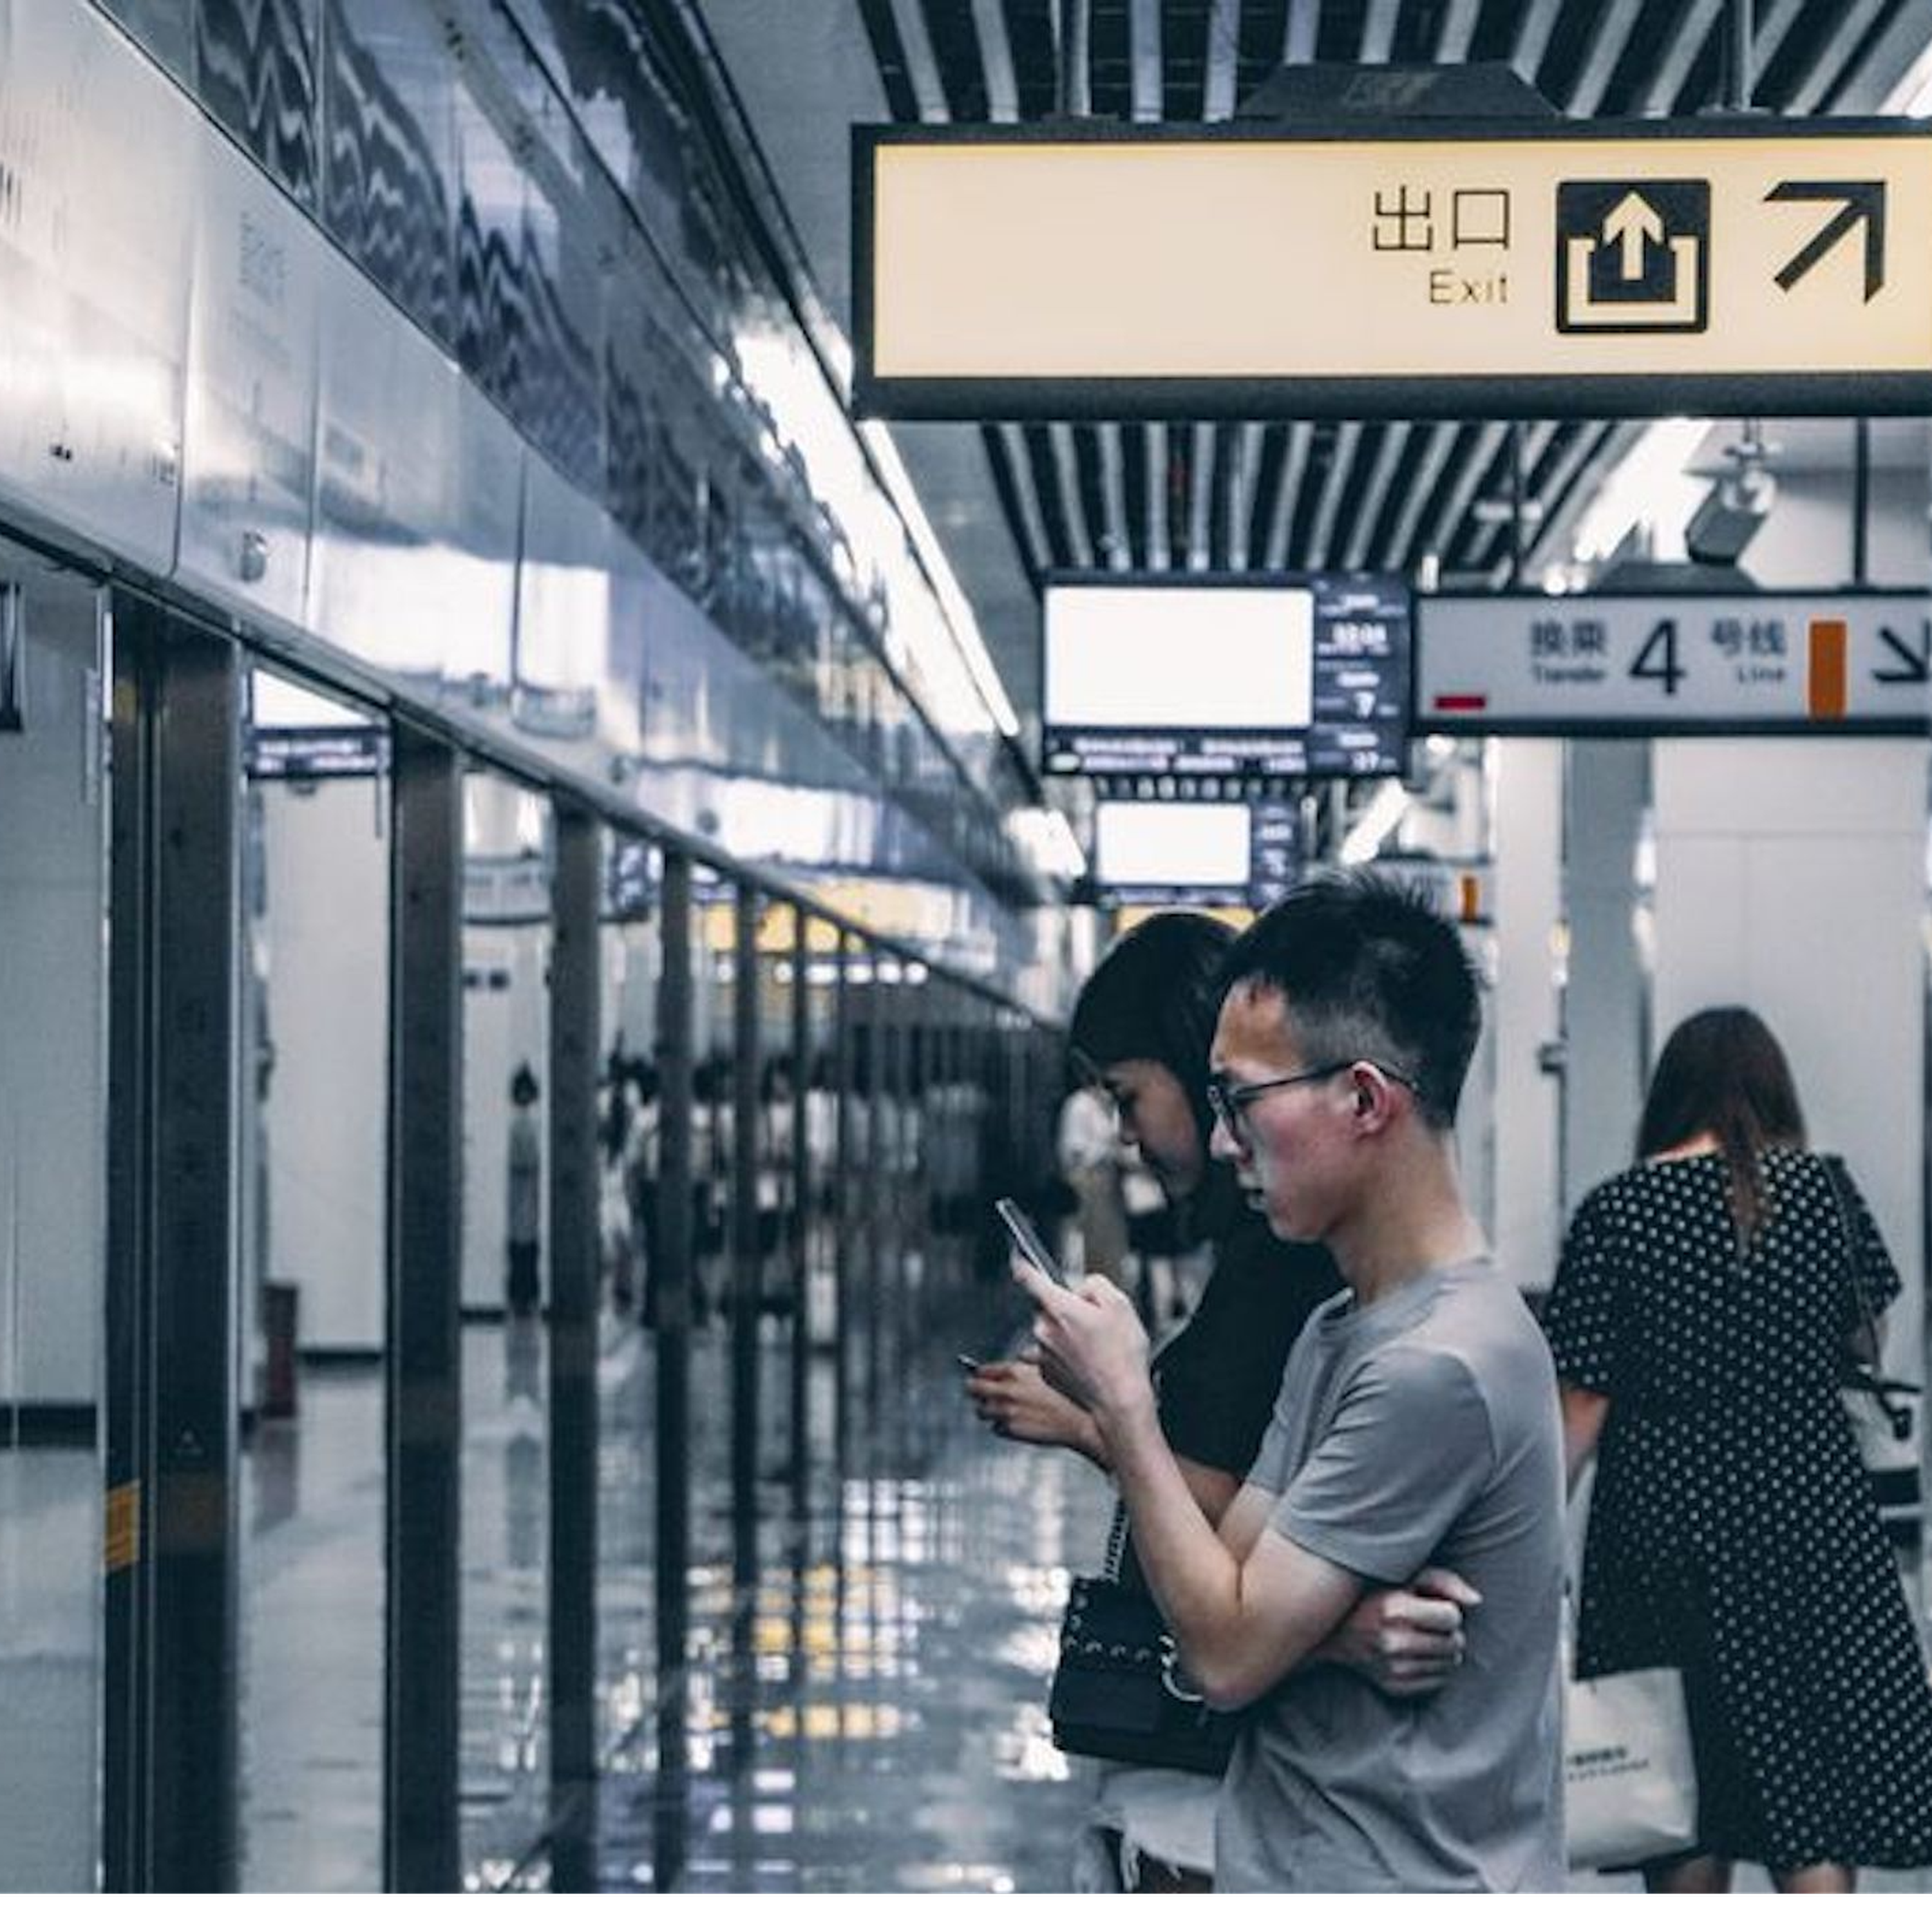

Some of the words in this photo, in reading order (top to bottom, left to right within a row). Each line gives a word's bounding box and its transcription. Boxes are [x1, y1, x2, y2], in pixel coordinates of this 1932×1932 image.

[1374, 185, 1510, 251] 出口
[1430, 269, 1508, 303] Exit
[1628, 618, 1686, 694] 4
